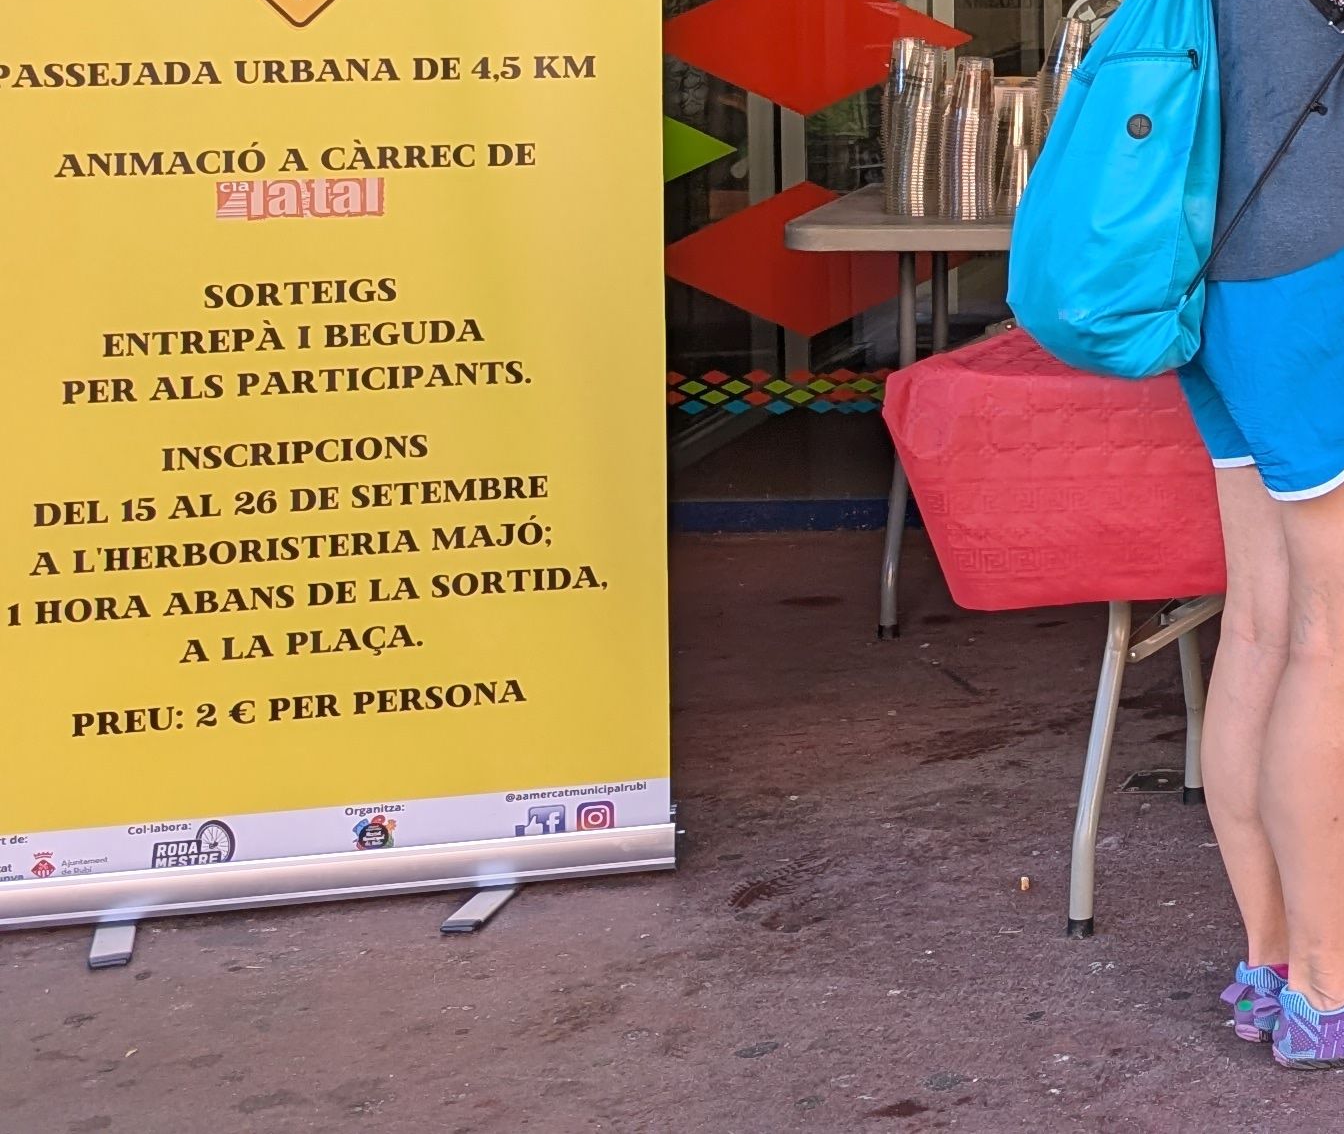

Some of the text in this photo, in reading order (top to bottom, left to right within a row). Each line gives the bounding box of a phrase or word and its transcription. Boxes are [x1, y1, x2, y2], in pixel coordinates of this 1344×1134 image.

[235, 59, 400, 84] URBANA
[413, 58, 460, 80] DE
[472, 57, 520, 81] 4,5
[534, 56, 595, 78] KM
[55, 142, 535, 177] ANIMACIÓ A CÀRREC DE
[205, 278, 396, 308] SORTEIGS
[103, 319, 484, 357] ENTREPÀ I BEGUDA
[63, 361, 531, 404] PER ALS PARTICIPANTS.
[162, 435, 427, 471] INSCRIPCIONS
[34, 476, 547, 527] DEL 15 AL 26 DE SETEMBRE
[30, 515, 551, 576] A L'HERBORISTERIA MAJÓ;
[8, 566, 607, 626] 1 HORA ABANS DE LA SORTIDA,
[180, 625, 423, 663] A LA PLAÇA.
[72, 680, 526, 737] PREU: 2 € PER PERSONA
[505, 781, 647, 803] @aamercatmunicipalrubi
[345, 804, 405, 816] Organitza:
[10, 836, 28, 845] de:
[157, 842, 198, 858] RODA
[62, 857, 108, 867] Ajuntament
[155, 851, 218, 867] MESTRE
